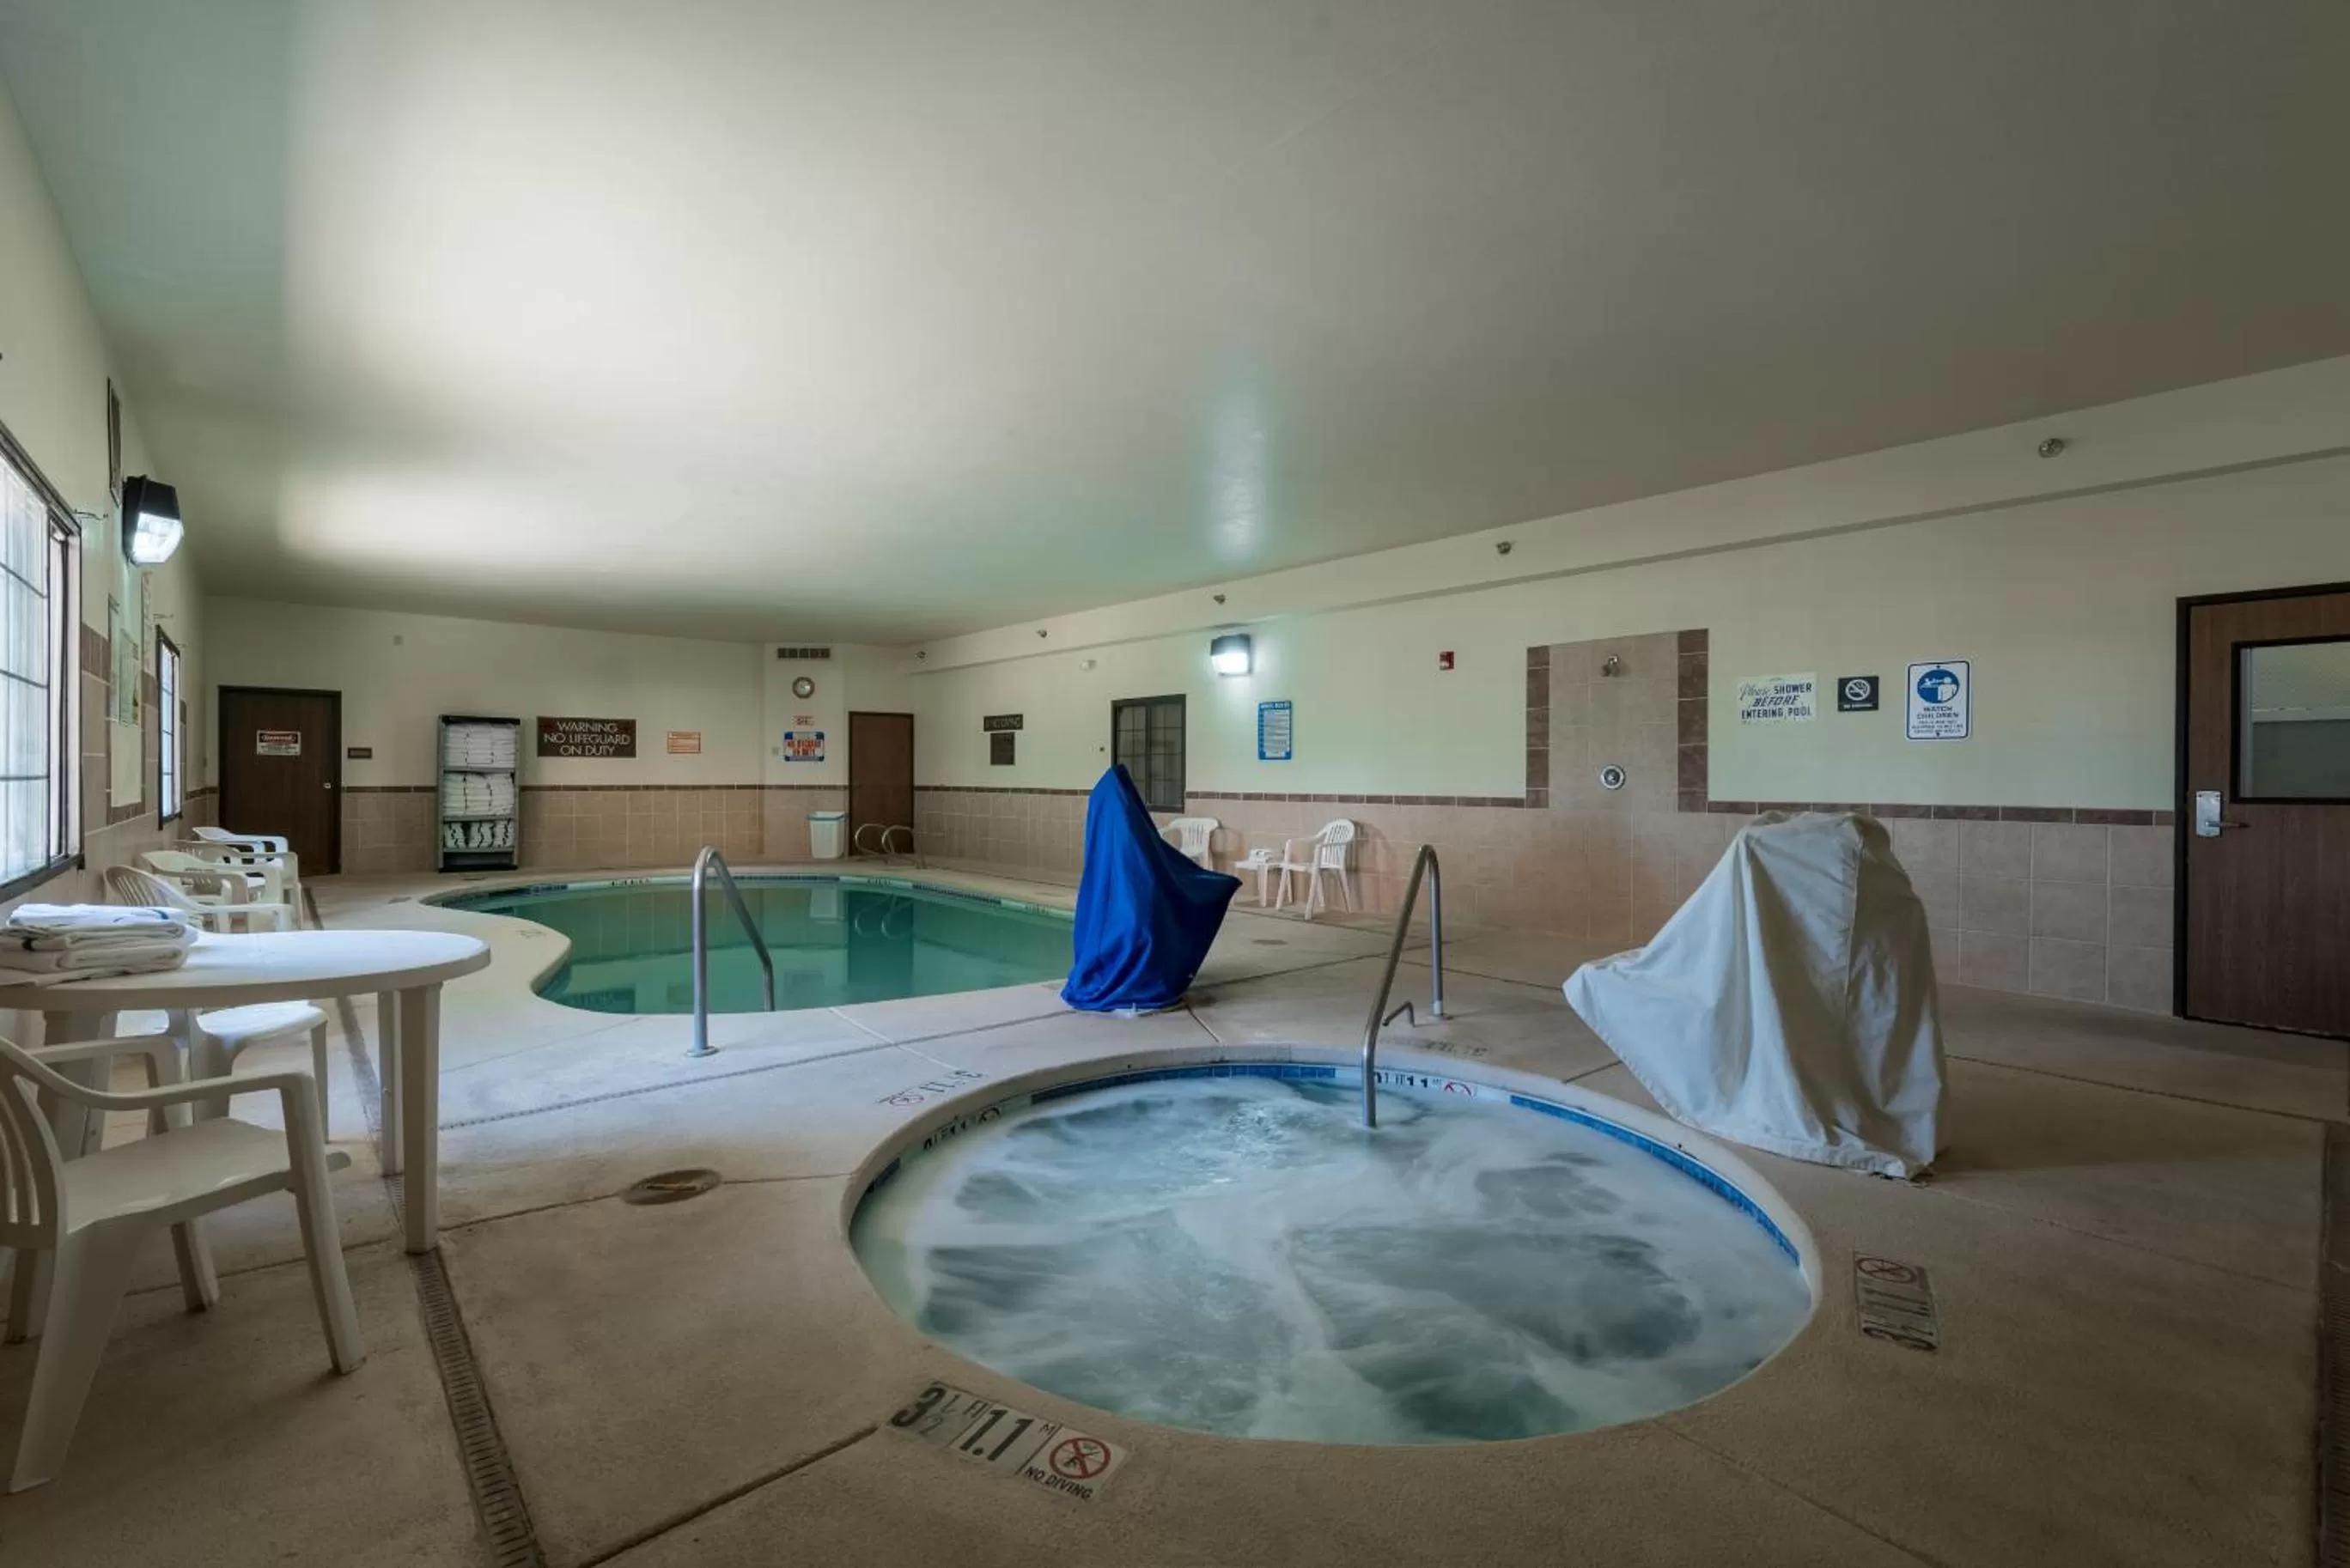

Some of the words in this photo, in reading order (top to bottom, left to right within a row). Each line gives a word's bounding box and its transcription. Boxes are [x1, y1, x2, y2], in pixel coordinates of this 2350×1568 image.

[1774, 683, 1812, 695] SHOWER
[1752, 695, 1799, 707] BEFORE
[1741, 708, 1784, 720] ENTERING
[1787, 705, 1811, 717] POOL
[557, 721, 618, 733] WARNING
[543, 732, 566, 744] NO
[569, 734, 630, 745] LIFEGUARD
[560, 744, 582, 757] ON
[585, 745, 616, 757] DUTY
[892, 1386, 946, 1427] 3
[959, 1409, 1035, 1462] 1.1
[1039, 1423, 1056, 1435] M
[1025, 1466, 1044, 1483] NO
[1044, 1475, 1094, 1499] DIVING
